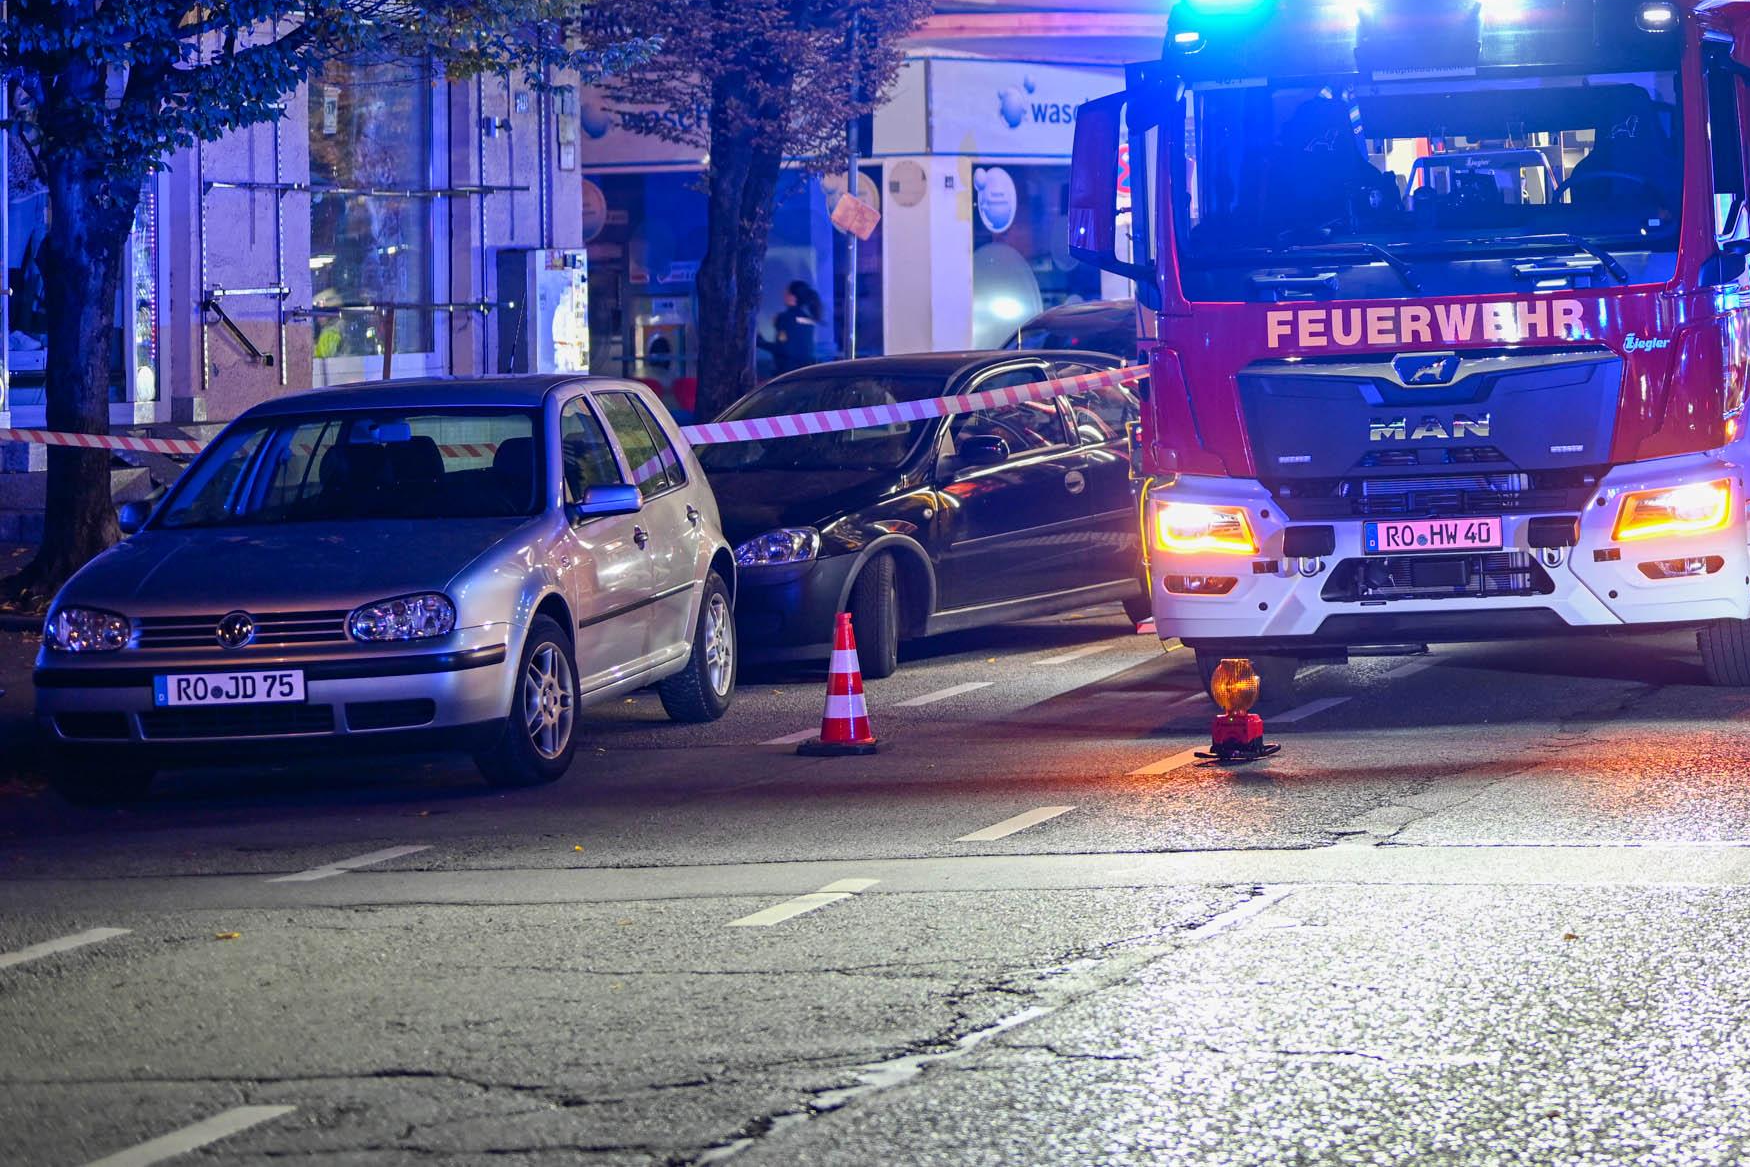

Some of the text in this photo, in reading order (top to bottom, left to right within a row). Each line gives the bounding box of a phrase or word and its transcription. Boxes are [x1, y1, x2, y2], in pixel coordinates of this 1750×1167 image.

[1266, 299, 1586, 347] FEUERWEHR
[1623, 332, 1670, 353] Ziegler
[1369, 414, 1490, 440] MAN
[1386, 522, 1491, 547] RO HW 40
[176, 674, 295, 701] RO JD 75
